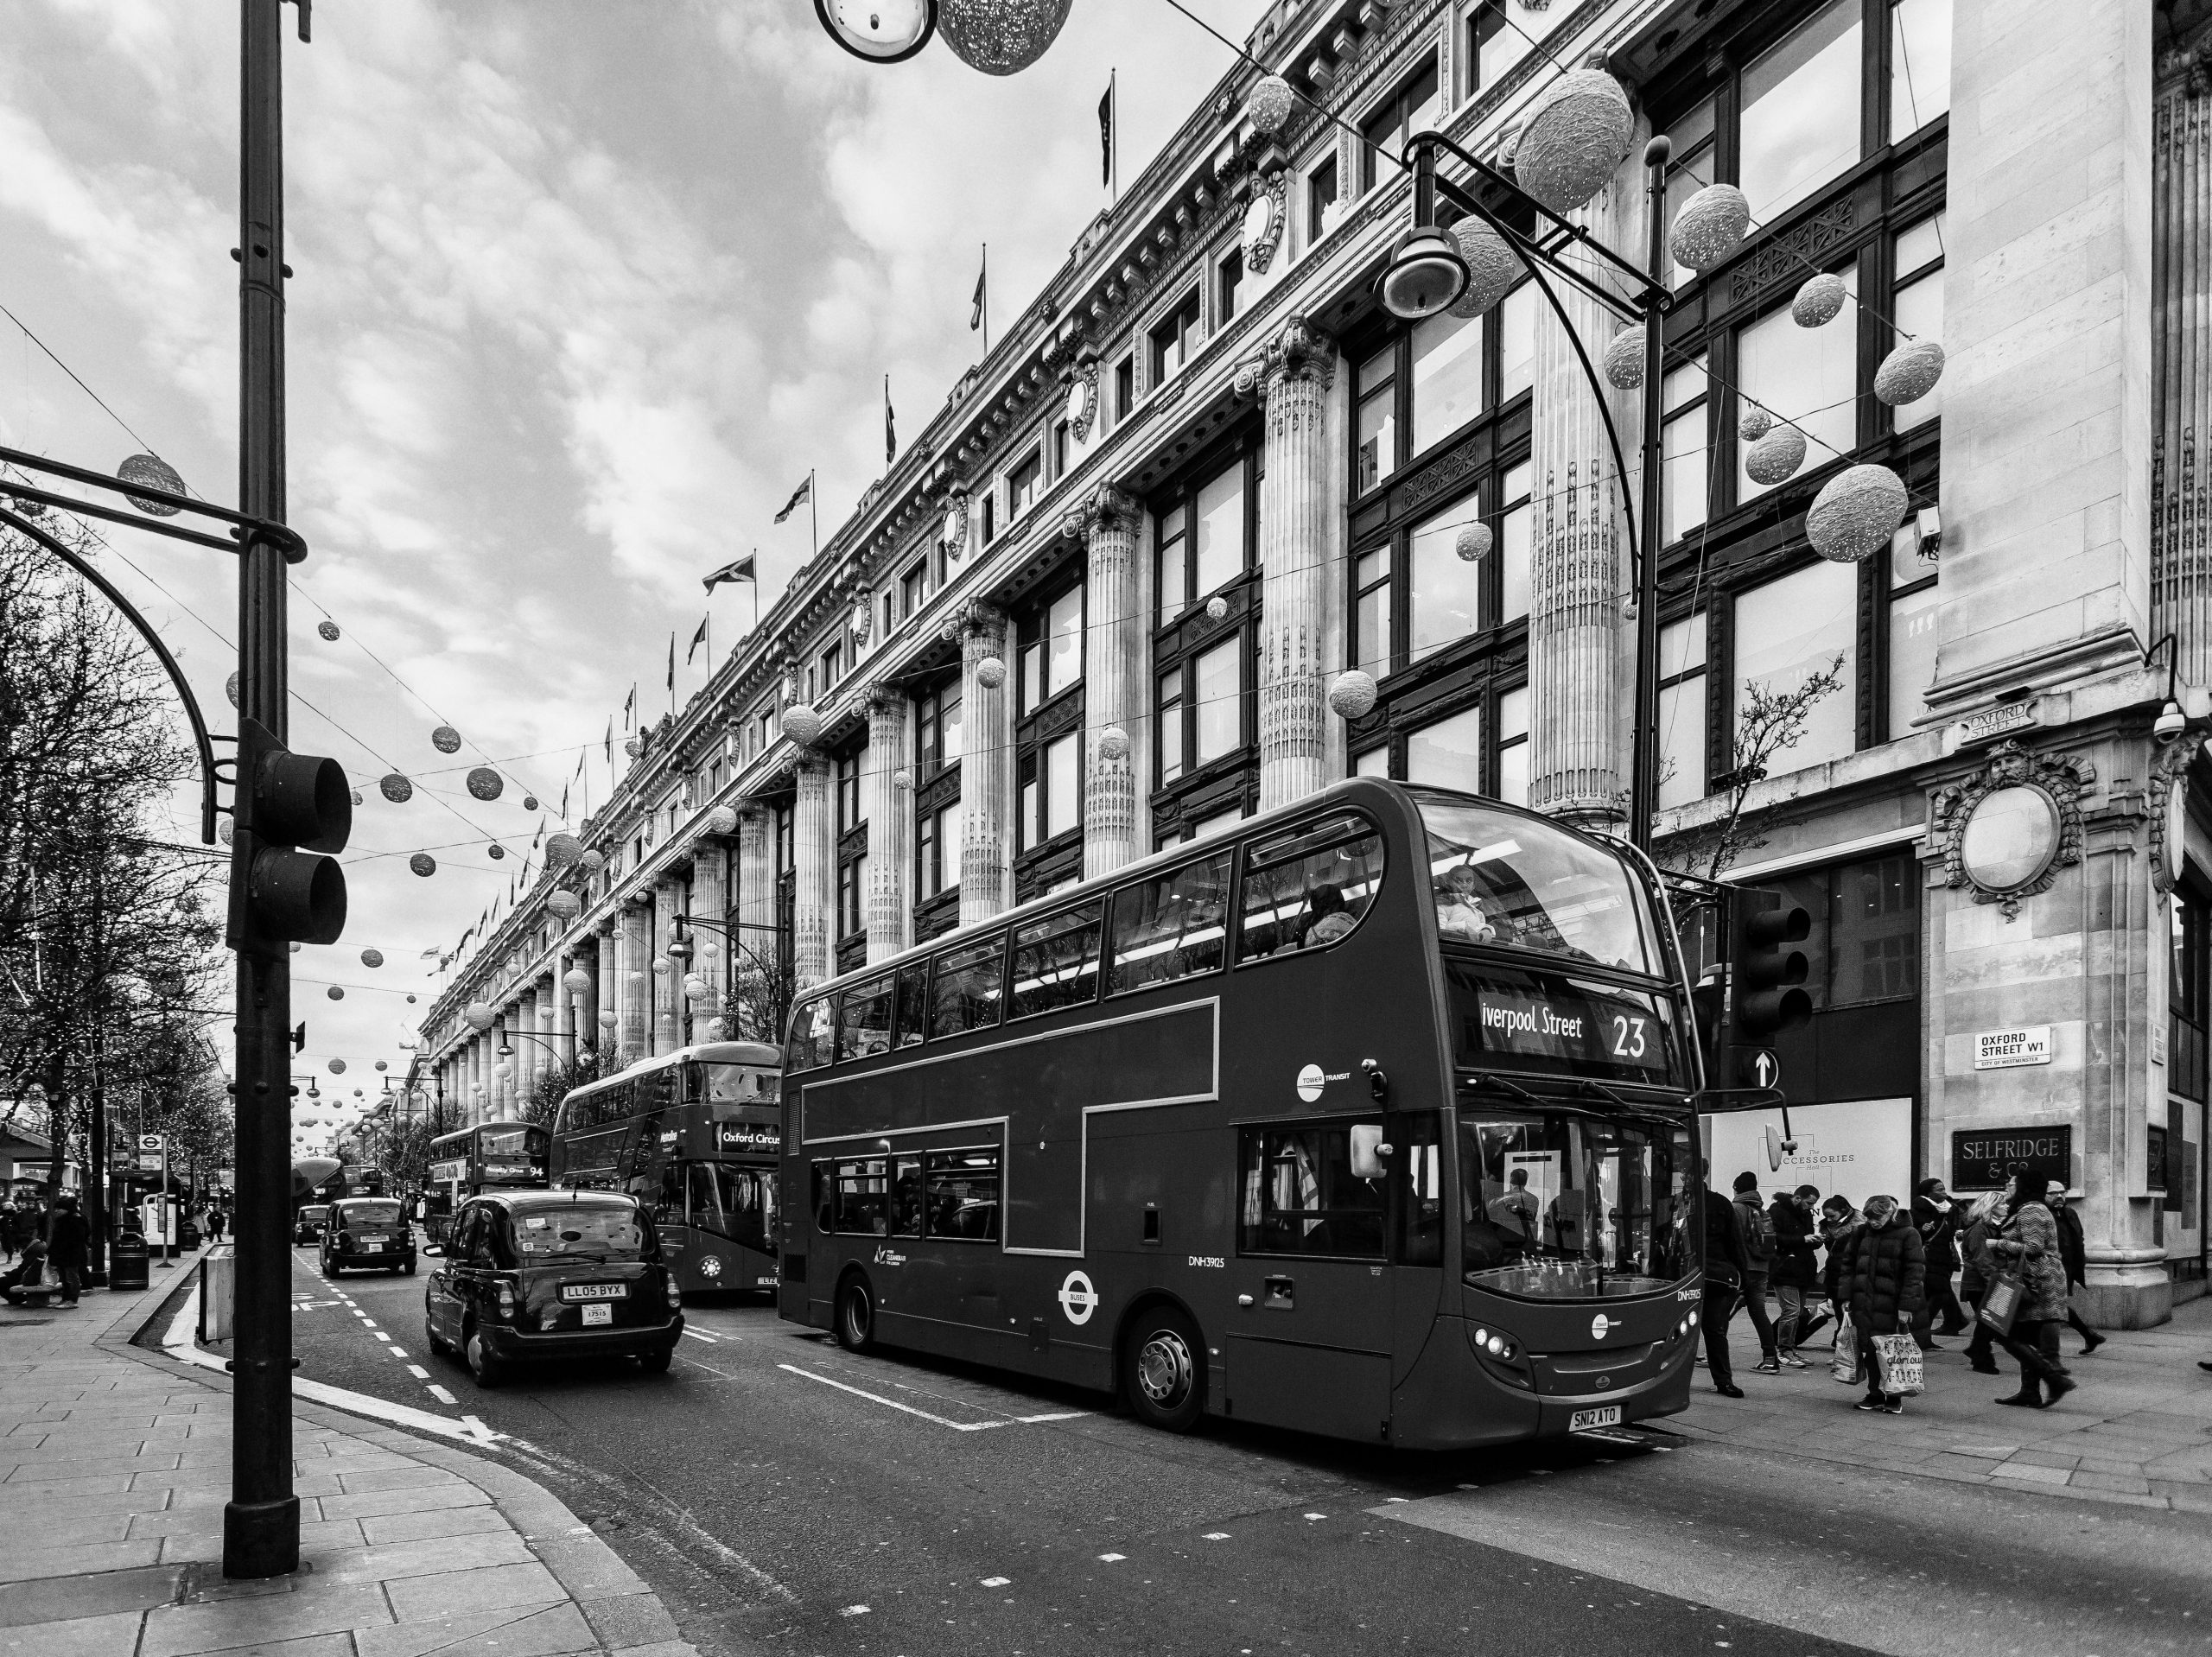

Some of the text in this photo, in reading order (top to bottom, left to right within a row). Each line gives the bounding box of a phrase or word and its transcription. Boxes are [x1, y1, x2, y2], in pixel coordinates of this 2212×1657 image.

[1970, 704, 2025, 728] OXFORD
[1972, 715, 2025, 739] STREET
[1482, 1002, 1582, 1038] iverpool Street
[1613, 1015, 1645, 1057] 23
[1981, 1032, 2026, 1046] OXFORD
[1981, 1041, 2044, 1057] STREET W1
[1302, 1072, 1351, 1084] TOWER TRANSIT
[722, 1132, 753, 1143] Oxford
[1962, 1138, 2059, 1159] SELFRIDGE
[1782, 1154, 1855, 1165] CCESSORIES
[530, 1166, 543, 1177] 94
[1988, 1162, 2002, 1178] &
[1188, 1255, 1224, 1268] DNH39125
[567, 1285, 621, 1297] LL05 BYX
[1070, 1293, 1085, 1302] BUSES
[1887, 1355, 1923, 1367] gloriou
[1574, 1407, 1616, 1428] SN12 ATO
